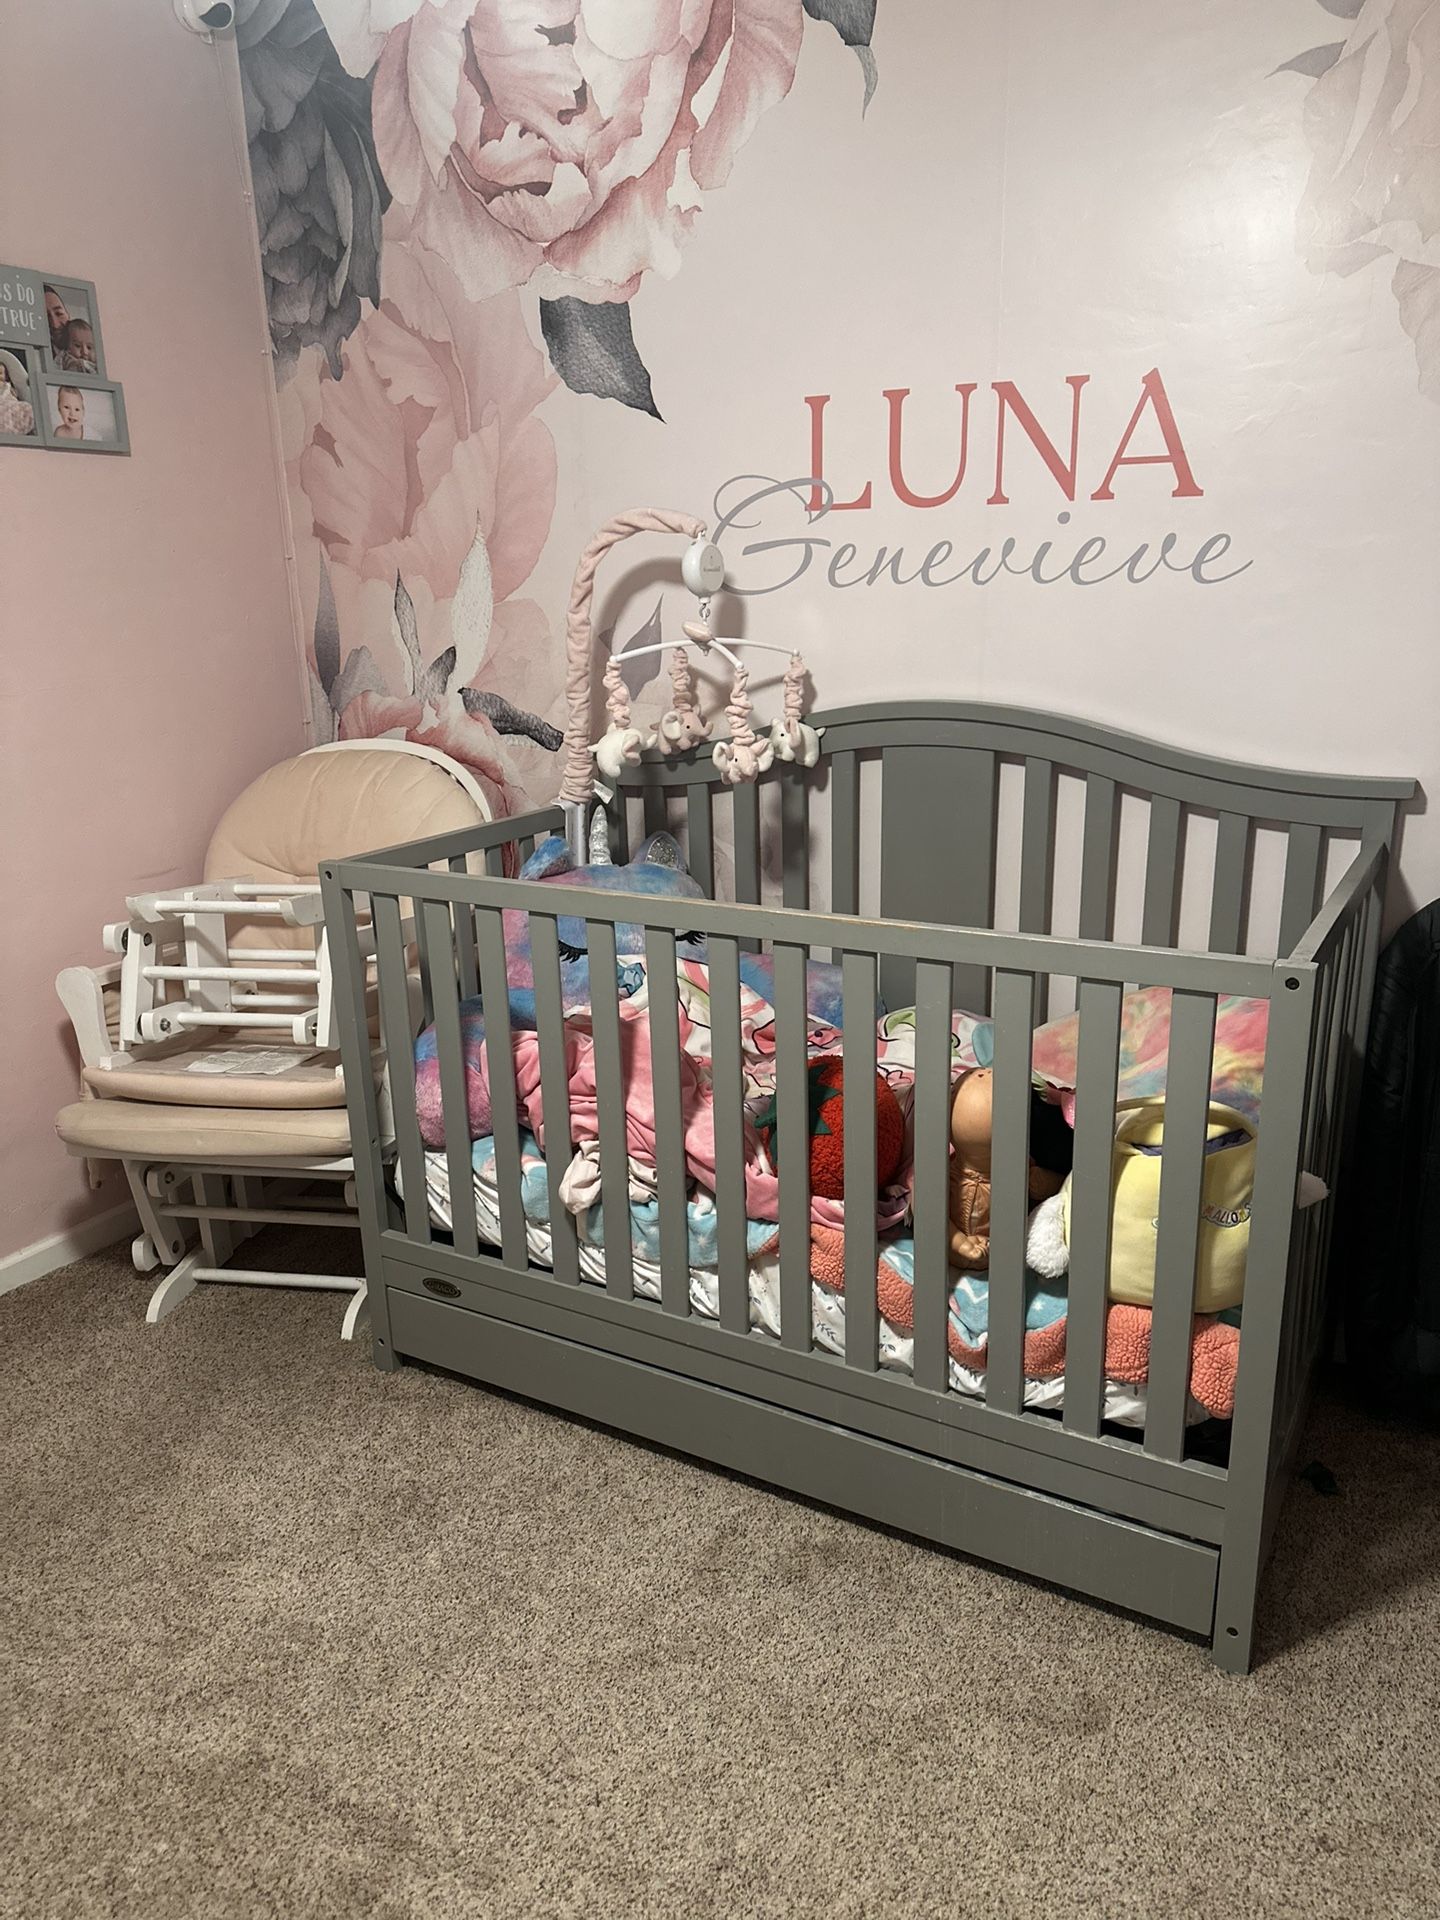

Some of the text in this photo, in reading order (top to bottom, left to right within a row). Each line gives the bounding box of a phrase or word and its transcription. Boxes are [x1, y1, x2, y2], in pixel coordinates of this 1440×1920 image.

[0, 283, 35, 306] S DO
[0, 306, 36, 330] TRUE
[805, 367, 1204, 511] LUNA
[711, 474, 1253, 596] Genevieve
